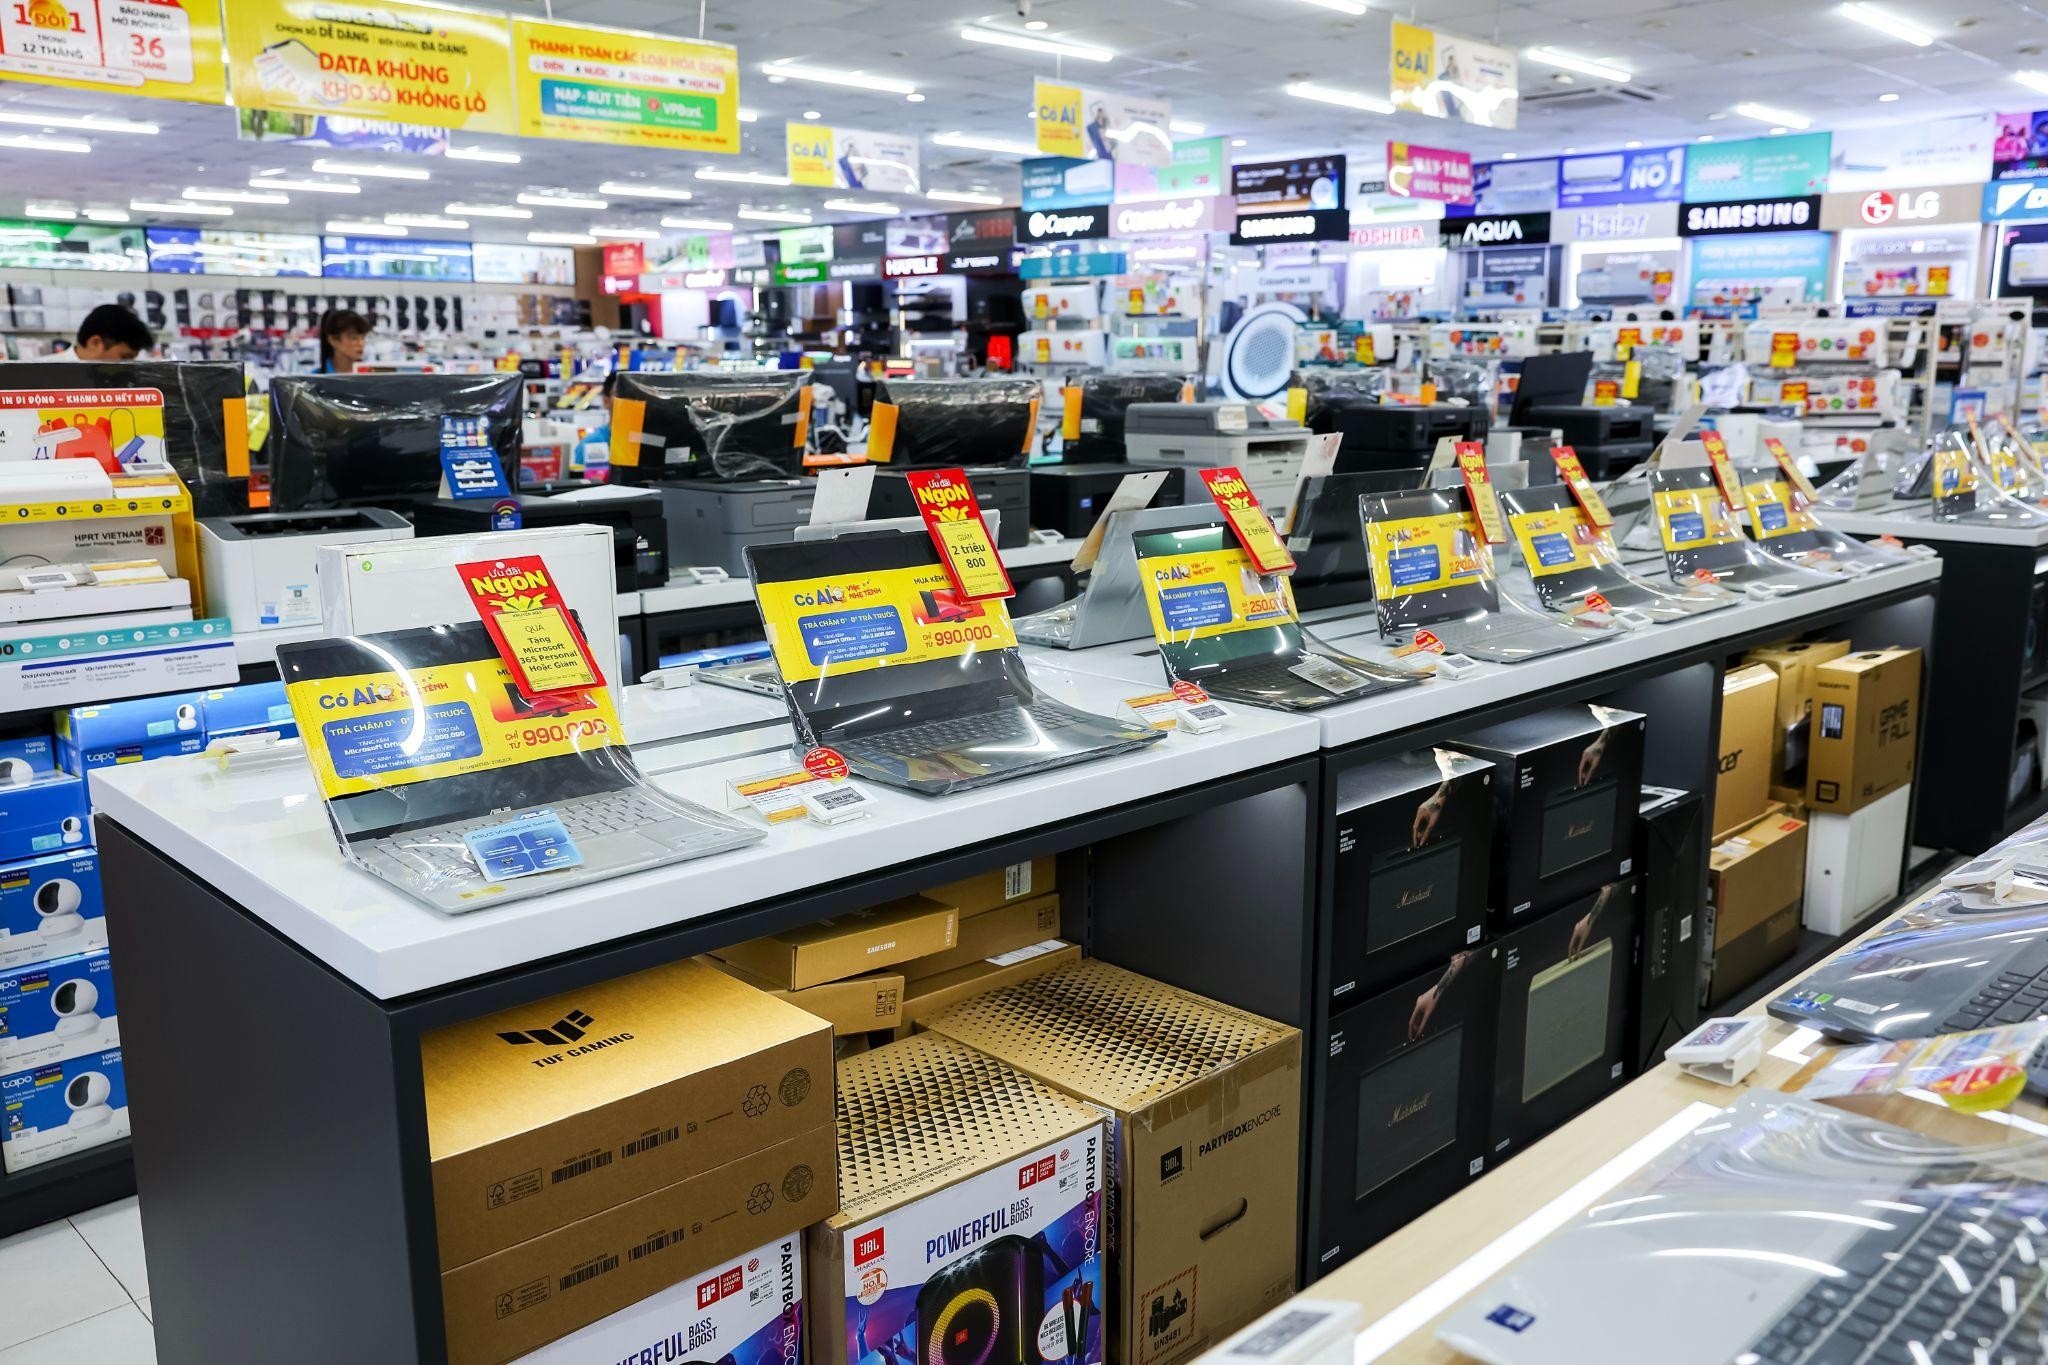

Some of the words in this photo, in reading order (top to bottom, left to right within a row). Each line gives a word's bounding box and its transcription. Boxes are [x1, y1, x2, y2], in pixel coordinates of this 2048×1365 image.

[14, 4, 31, 25] 1
[69, 12, 86, 33] 1
[319, 25, 334, 39] DỄ
[337, 28, 369, 44] DÀNG
[23, 43, 36, 53] 12
[41, 44, 83, 60] THÁNG
[130, 34, 165, 59] 36
[528, 39, 574, 55] THANH
[578, 45, 612, 60] TOÁN
[614, 49, 638, 63] CÁC
[319, 52, 372, 76] DATA
[376, 58, 449, 84] KHỦNG
[323, 81, 364, 100] KHO
[368, 82, 391, 102] SỐ
[397, 84, 461, 110] KHỔNG
[465, 91, 487, 113] LỒ
[554, 87, 582, 105] NẠP
[1629, 163, 1666, 190] NO
[1667, 147, 1685, 185] 1
[1898, 191, 1940, 219] LG
[1046, 213, 1094, 236] Casper
[1577, 210, 1649, 237] Haier
[1688, 201, 1810, 231] SAMSUNG
[1350, 225, 1424, 246] TOSHIBA
[1463, 220, 1523, 242] AQUA
[2, 395, 13, 405] IN
[16, 396, 26, 405] DI
[29, 395, 55, 406] ĐỘNG
[66, 394, 98, 404] KHÔNG
[101, 395, 113, 404] LO
[116, 393, 132, 403] HẾT
[135, 393, 158, 403] MỰC
[928, 480, 940, 489] Ưu
[939, 478, 952, 488] đãi
[1208, 478, 1248, 498] NgoN
[916, 482, 971, 509] NgoN
[74, 532, 99, 542] HPRT
[102, 529, 143, 541] VIETNAM
[956, 532, 974, 542] GIẢM
[1245, 528, 1253, 537] 2
[1252, 525, 1270, 537] triệu
[951, 544, 960, 556] 2
[960, 542, 987, 556] triệu
[488, 567, 505, 578] Ưu
[506, 566, 521, 577] đãi
[965, 556, 987, 570] 800
[471, 569, 549, 597] NgoN
[914, 576, 929, 585] MUA
[930, 573, 945, 583] KÈM
[1155, 568, 1169, 582] Có
[794, 592, 815, 607] Có
[817, 584, 834, 606] AI
[848, 592, 865, 601] NHẸ
[864, 587, 883, 597] TÊNH
[1249, 598, 1288, 614] 250.00
[524, 623, 545, 634] QUÀ
[803, 621, 819, 630] TRẢ
[818, 619, 840, 628] CHẬM
[858, 614, 873, 622] TRẢ
[873, 610, 896, 620] TRƯỚC
[527, 635, 552, 646] Tặng
[840, 635, 857, 643] Office
[922, 631, 933, 642] CHỈ
[934, 624, 994, 647] 990.000
[522, 642, 566, 655] Microsoft
[925, 641, 934, 650] TỪ
[519, 656, 537, 665] 365
[538, 650, 578, 663] Personal
[528, 662, 553, 674] Hoặc
[553, 659, 578, 671] Giảm
[422, 681, 449, 694] TÊNH
[319, 691, 349, 710] Có
[329, 725, 352, 737] TRẢ
[353, 721, 384, 734] CHẬM
[433, 707, 467, 720] TRƯỚC
[427, 730, 466, 742] 2.000.000
[504, 728, 520, 741] CHỈ
[522, 717, 608, 747] 990.000
[343, 743, 384, 756] Microsoft
[358, 738, 375, 748] TẶNG
[508, 740, 522, 751] TỪ
[86, 751, 115, 764] tapo
[363, 757, 378, 766] HỌC
[377, 755, 393, 764] SINH
[371, 761, 389, 771] GIẢM
[389, 758, 407, 768] THÊM
[419, 751, 452, 763] 500.000
[1718, 749, 1743, 775] cer
[489, 806, 512, 816] ASUS
[519, 809, 551, 821] ASUS
[471, 832, 495, 841] ASUS
[495, 824, 532, 836] Vivobook
[531, 818, 557, 829] Series
[1565, 819, 1594, 840] Marshall
[72, 860, 93, 869] 1080p
[1396, 884, 1435, 910] Marshall
[866, 941, 897, 955] SAMSUNG
[89, 959, 110, 969] 1080p
[89, 966, 101, 974] Full
[531, 1053, 564, 1069] TUF
[566, 1032, 636, 1058] GAMING
[102, 1059, 114, 1067] Full
[2, 1075, 32, 1089] tapo
[1386, 1092, 1432, 1128] Marshall
[1166, 1155, 1180, 1172] JBL
[1010, 1197, 1031, 1215] BASS
[1010, 1205, 1034, 1227] BOOST
[925, 1208, 1011, 1265] POWERFUL
[859, 1237, 880, 1257] JBL
[856, 1256, 886, 1274] HARMAN
[722, 1271, 741, 1283] DESIGN
[722, 1276, 741, 1288] AWARD
[701, 1282, 716, 1304] iF
[688, 1316, 712, 1338] BASS
[688, 1326, 719, 1352] BOOST
[1154, 1328, 1182, 1350] UN3481
